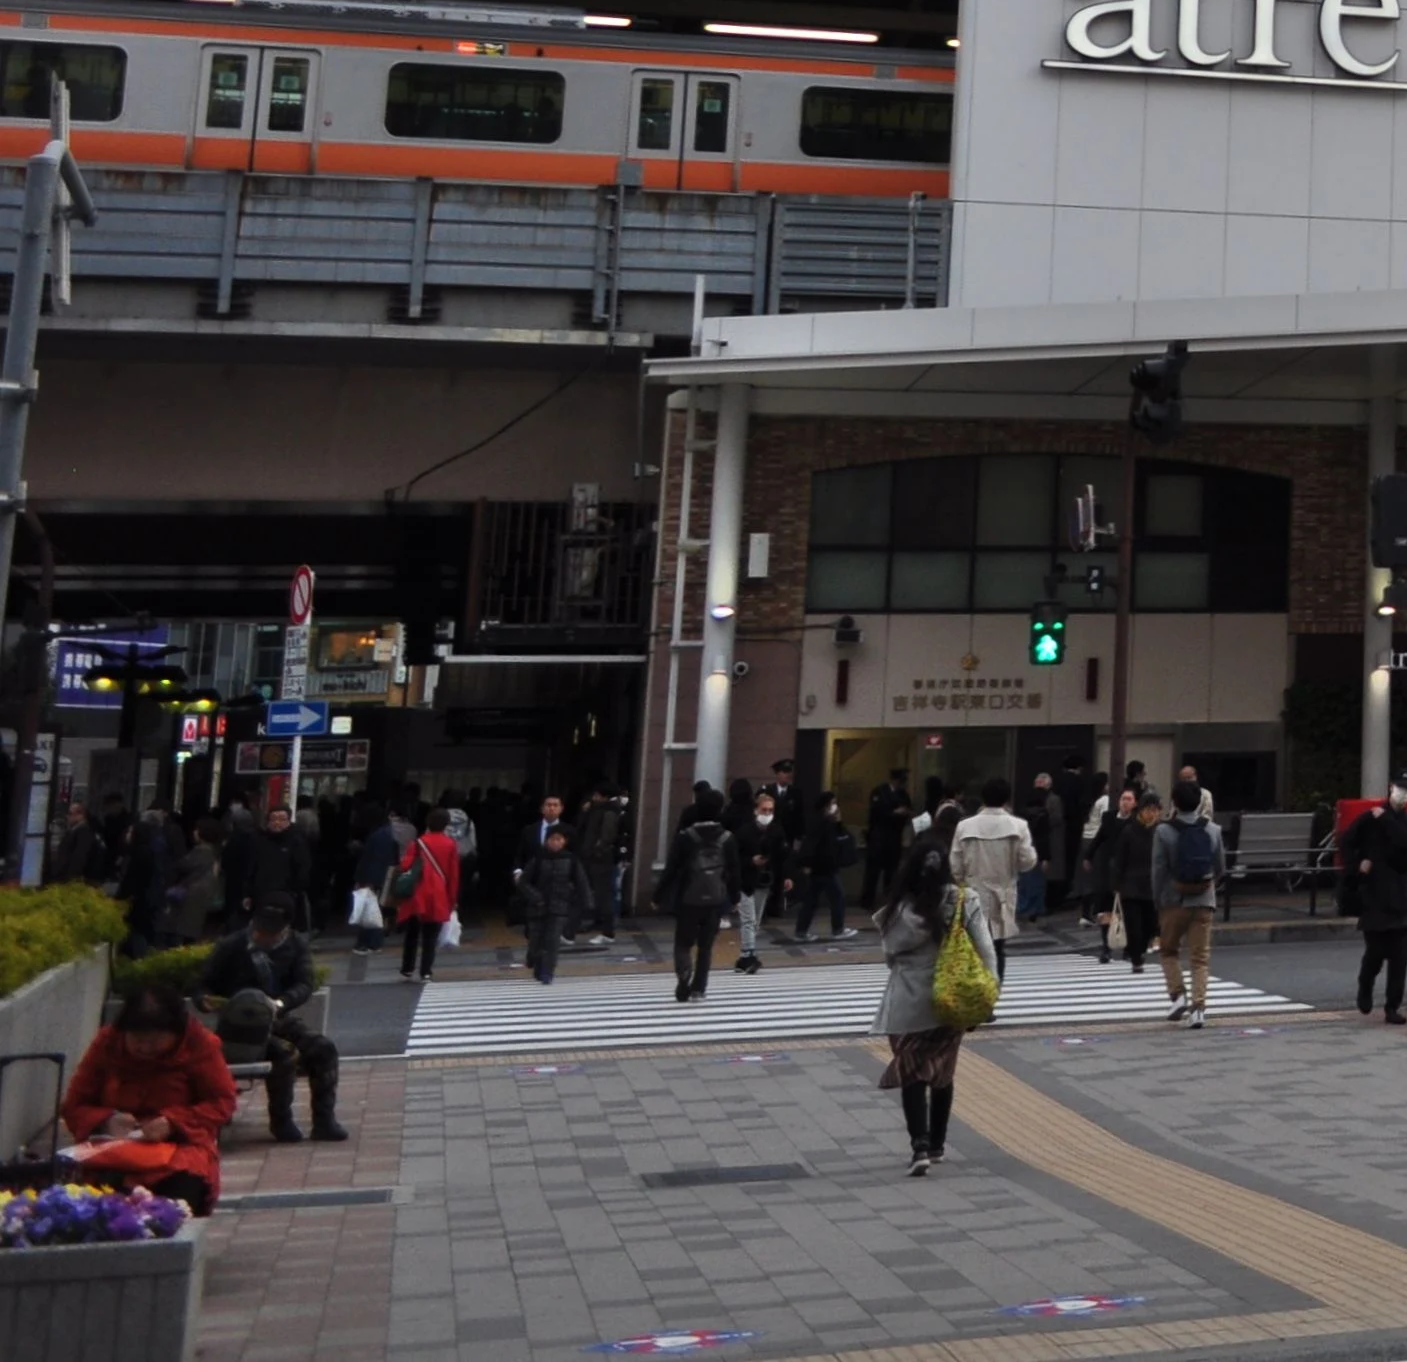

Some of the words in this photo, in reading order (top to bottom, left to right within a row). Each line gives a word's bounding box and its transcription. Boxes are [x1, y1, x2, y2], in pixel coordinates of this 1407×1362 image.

[892, 692, 1043, 712] 吉祥寺駅東口交番
